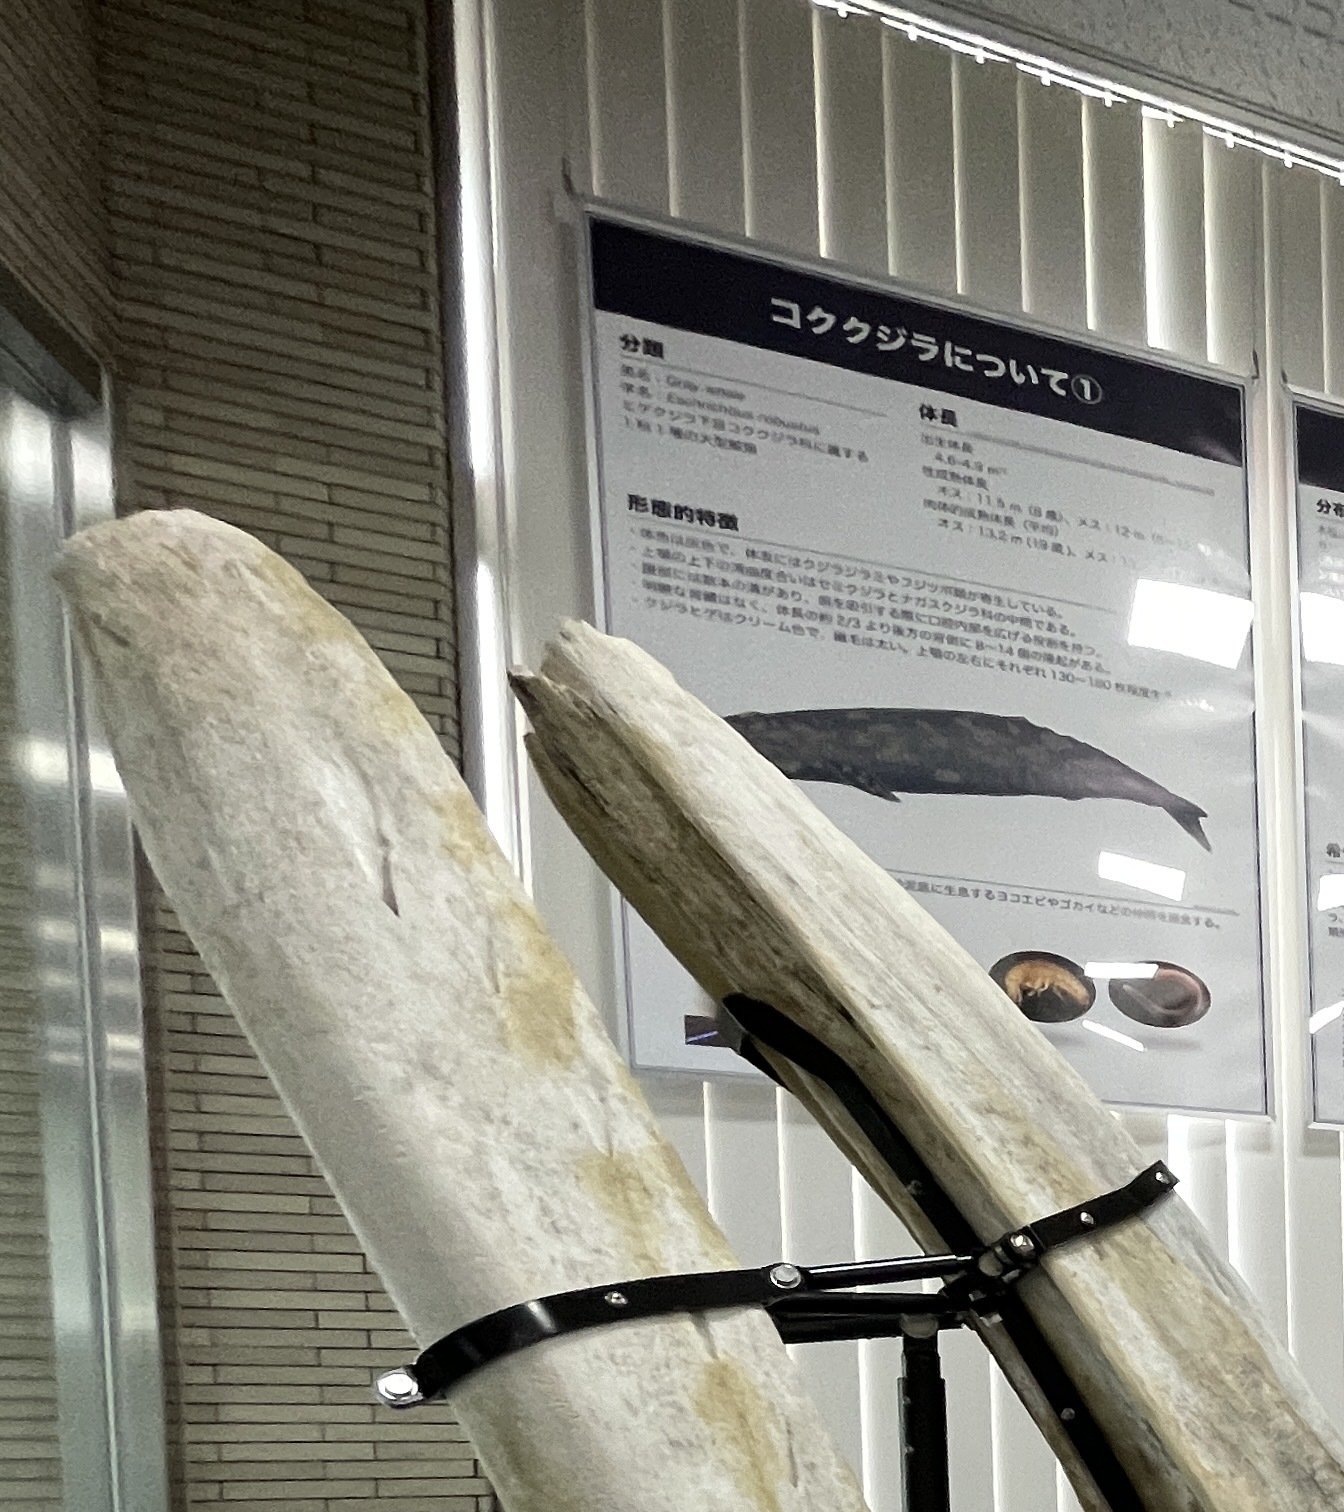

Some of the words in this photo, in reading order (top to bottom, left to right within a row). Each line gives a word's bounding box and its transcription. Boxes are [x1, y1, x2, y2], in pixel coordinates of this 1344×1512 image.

[769, 293, 1103, 408] コククジラについて①
[626, 492, 739, 534] 形態的特徴
